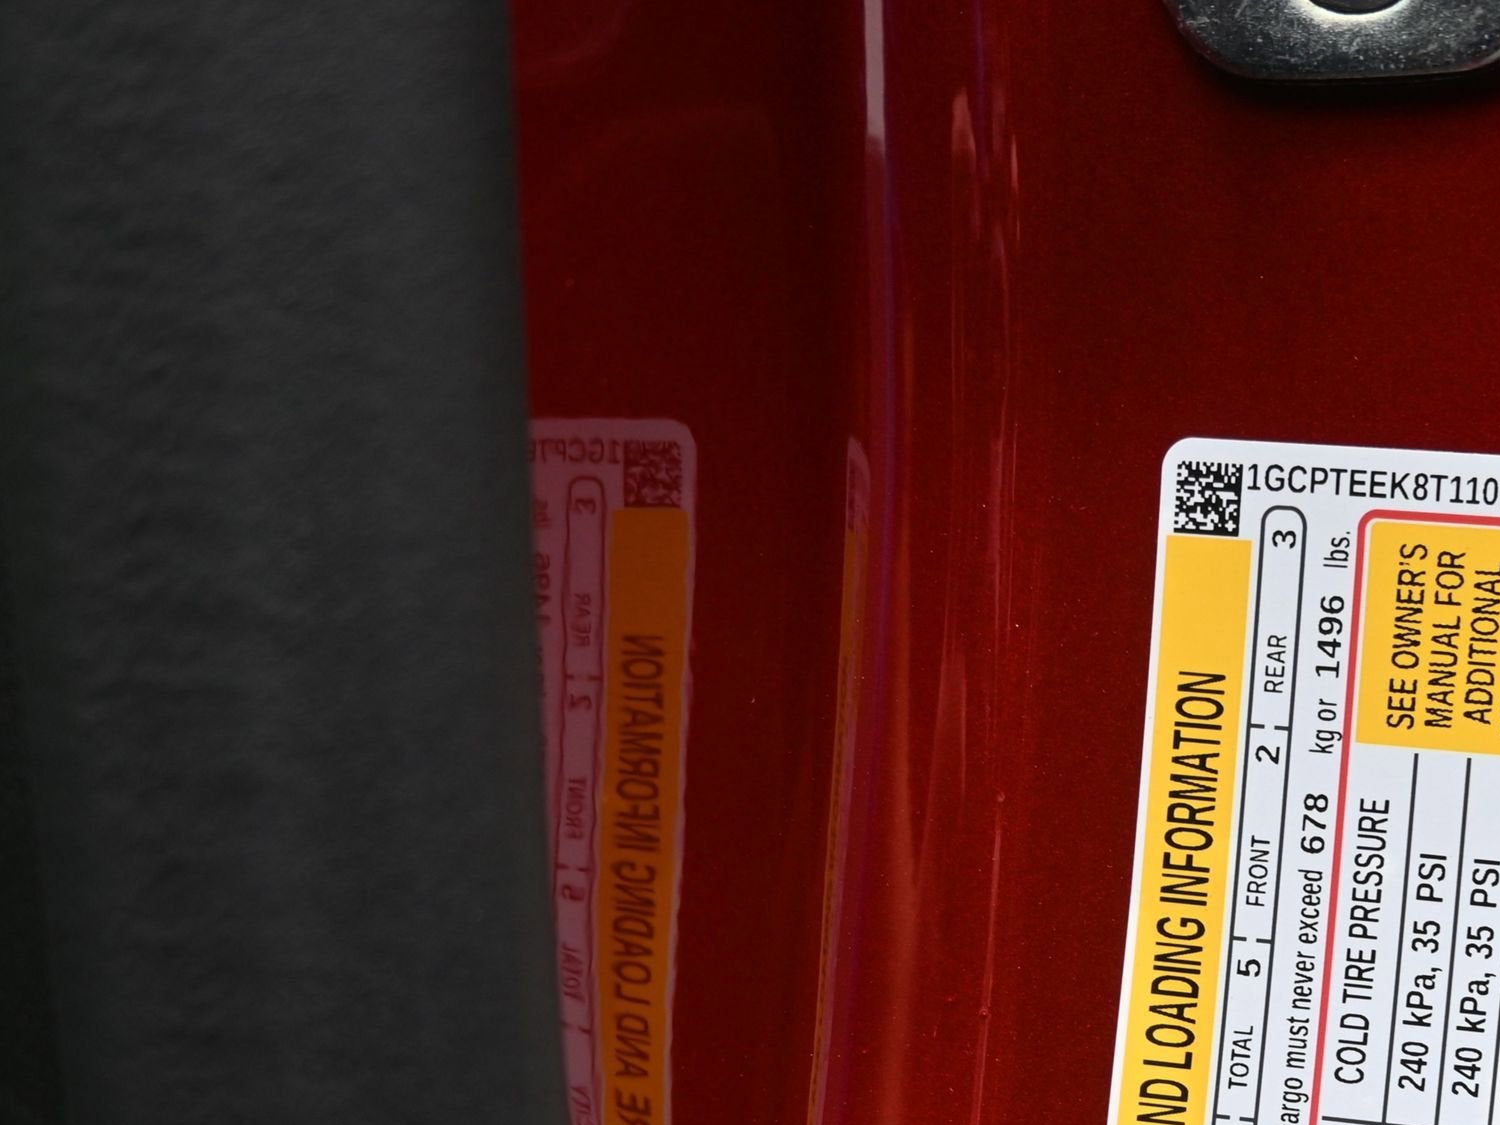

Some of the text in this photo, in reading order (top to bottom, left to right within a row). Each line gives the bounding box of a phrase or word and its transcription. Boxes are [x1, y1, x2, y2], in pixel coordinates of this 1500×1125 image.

[1264, 530, 1296, 693] REAR 3
[1323, 532, 1350, 568] lbs.
[1315, 596, 1344, 678] 1496
[1386, 544, 1428, 729] SEE OWNER'S
[1424, 551, 1465, 729] MANUAL FOR
[1309, 730, 1343, 754] kg
[1318, 698, 1337, 721] or
[1160, 671, 1226, 906] INFORMATION
[1246, 745, 1280, 906] FRONT 2
[1301, 793, 1328, 854] 678
[1298, 869, 1323, 944] exceed
[1334, 798, 1390, 1084] COLD TIRE PRESSURE
[1398, 853, 1447, 1092] 240 kPa, 35 PSI
[1143, 917, 1205, 1070] LOADING
[1228, 959, 1261, 1089] TOTAL 5
[1286, 1016, 1309, 1069] must
[1292, 951, 1315, 1010] never
[1452, 859, 1500, 1098] 240 kPa, 35 PSI
